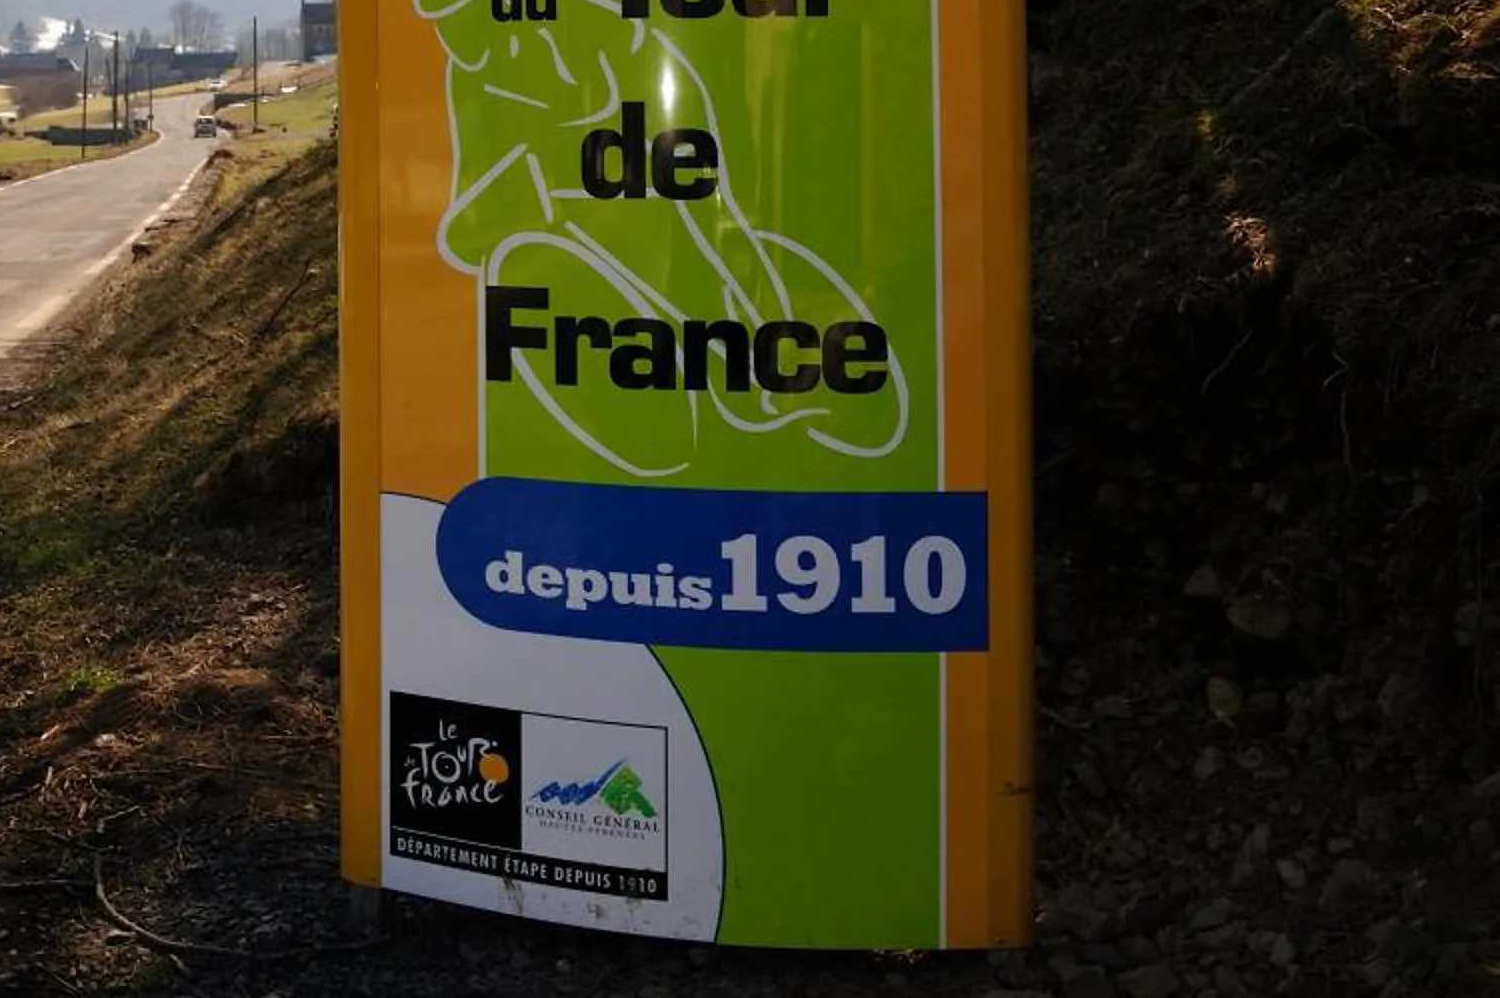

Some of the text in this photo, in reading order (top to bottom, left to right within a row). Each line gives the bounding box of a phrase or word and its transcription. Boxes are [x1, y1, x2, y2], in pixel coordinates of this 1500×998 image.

[580, 101, 718, 200] de
[484, 285, 888, 394] France
[485, 533, 967, 615] depuis 1910
[396, 837, 498, 870] DÉPARTEMENT
[503, 855, 548, 880] ÉTAPE
[525, 806, 661, 834] CONSEIL GÉNÉRAL
